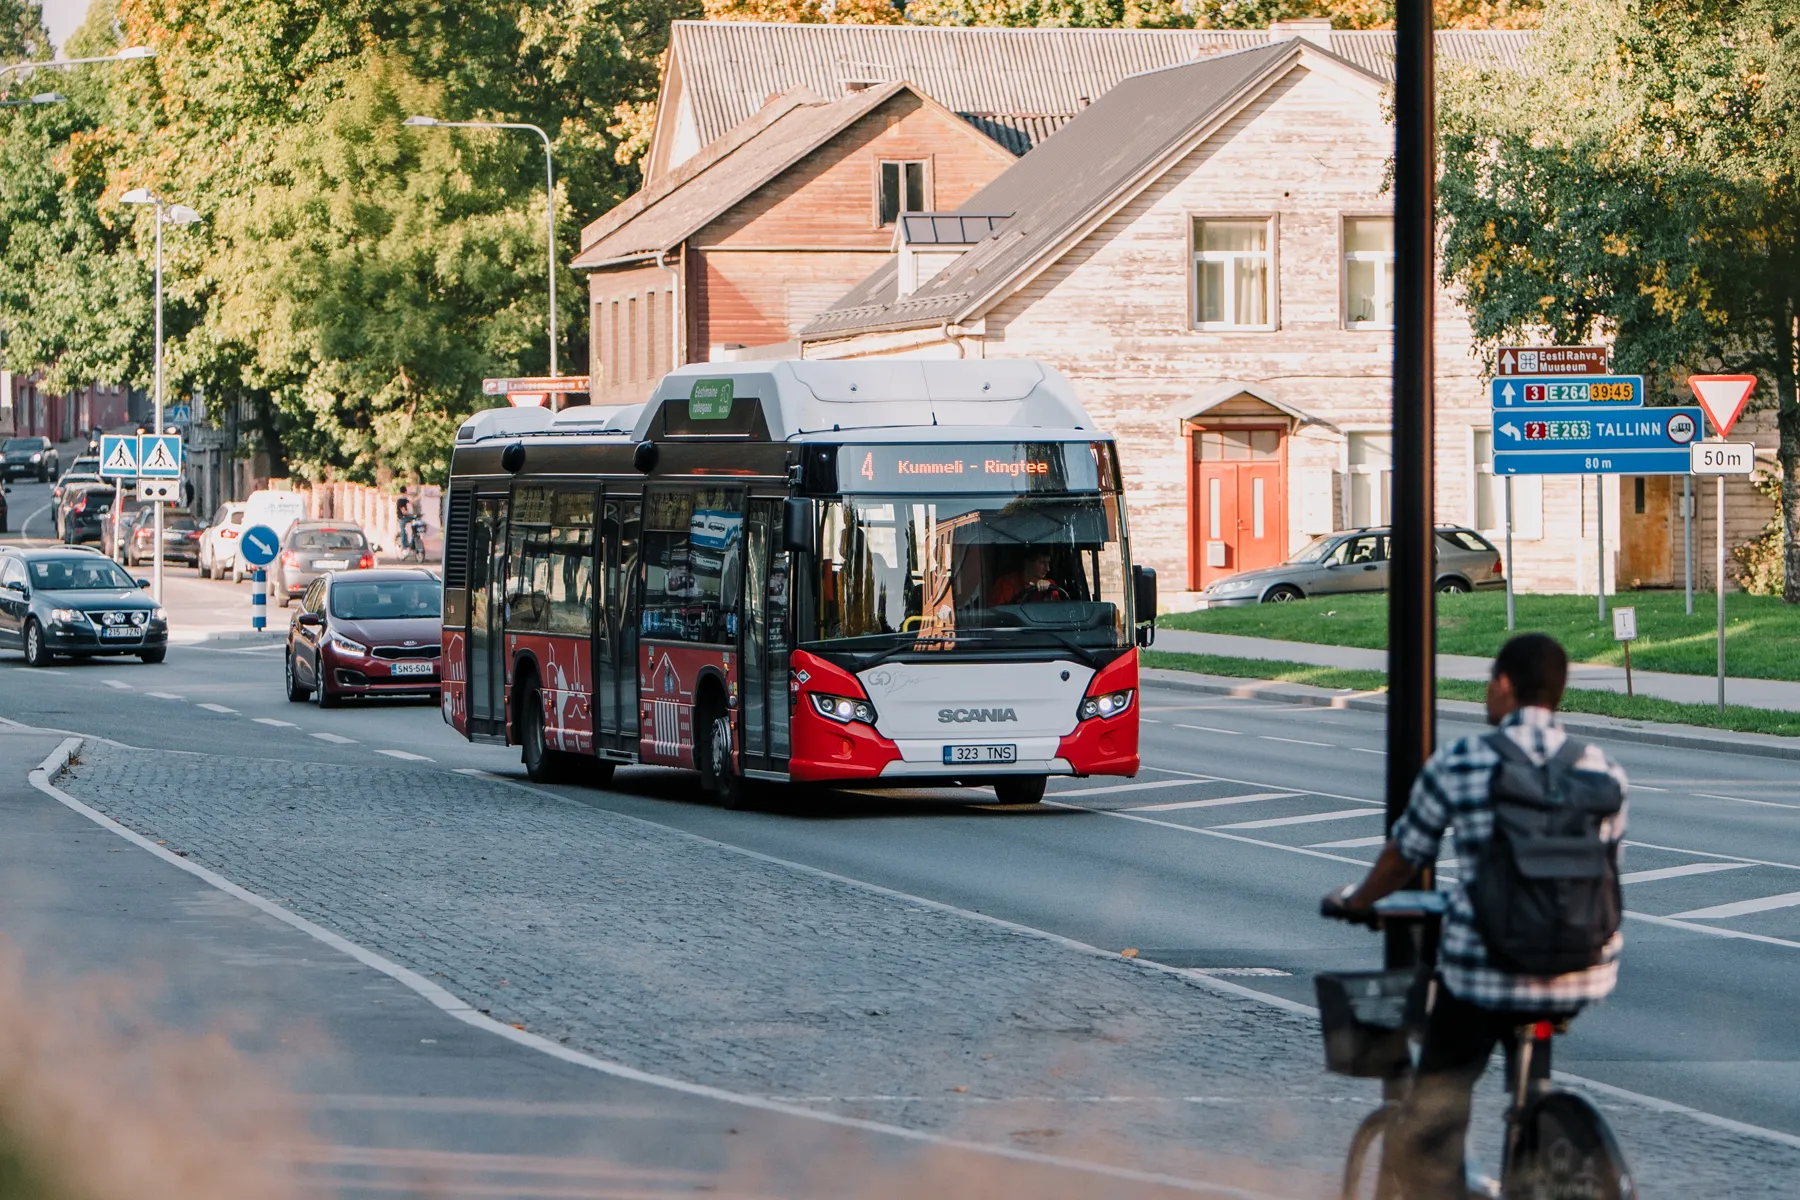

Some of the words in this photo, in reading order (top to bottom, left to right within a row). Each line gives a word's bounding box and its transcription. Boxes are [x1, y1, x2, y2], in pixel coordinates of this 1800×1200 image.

[1539, 350, 1565, 361] Eesti
[1566, 350, 1597, 361] Rahva
[1599, 356, 1605, 366] 2
[1539, 362, 1587, 372] Muuseum
[1530, 386, 1539, 400] 3
[1592, 385, 1609, 398] 39
[1613, 384, 1630, 398] 45
[1531, 423, 1540, 438] 2
[1595, 422, 1661, 437] TALLINN
[861, 452, 874, 480] 4
[898, 460, 963, 474] Kummeli
[984, 459, 1049, 477] Ringtee
[1584, 457, 1599, 469] 80
[108, 628, 121, 636] 215
[125, 628, 140, 636] JZN
[397, 664, 431, 673] SNS-504
[937, 707, 1019, 724] SCANIA
[957, 747, 979, 760] 323
[986, 746, 1012, 760] TNS
